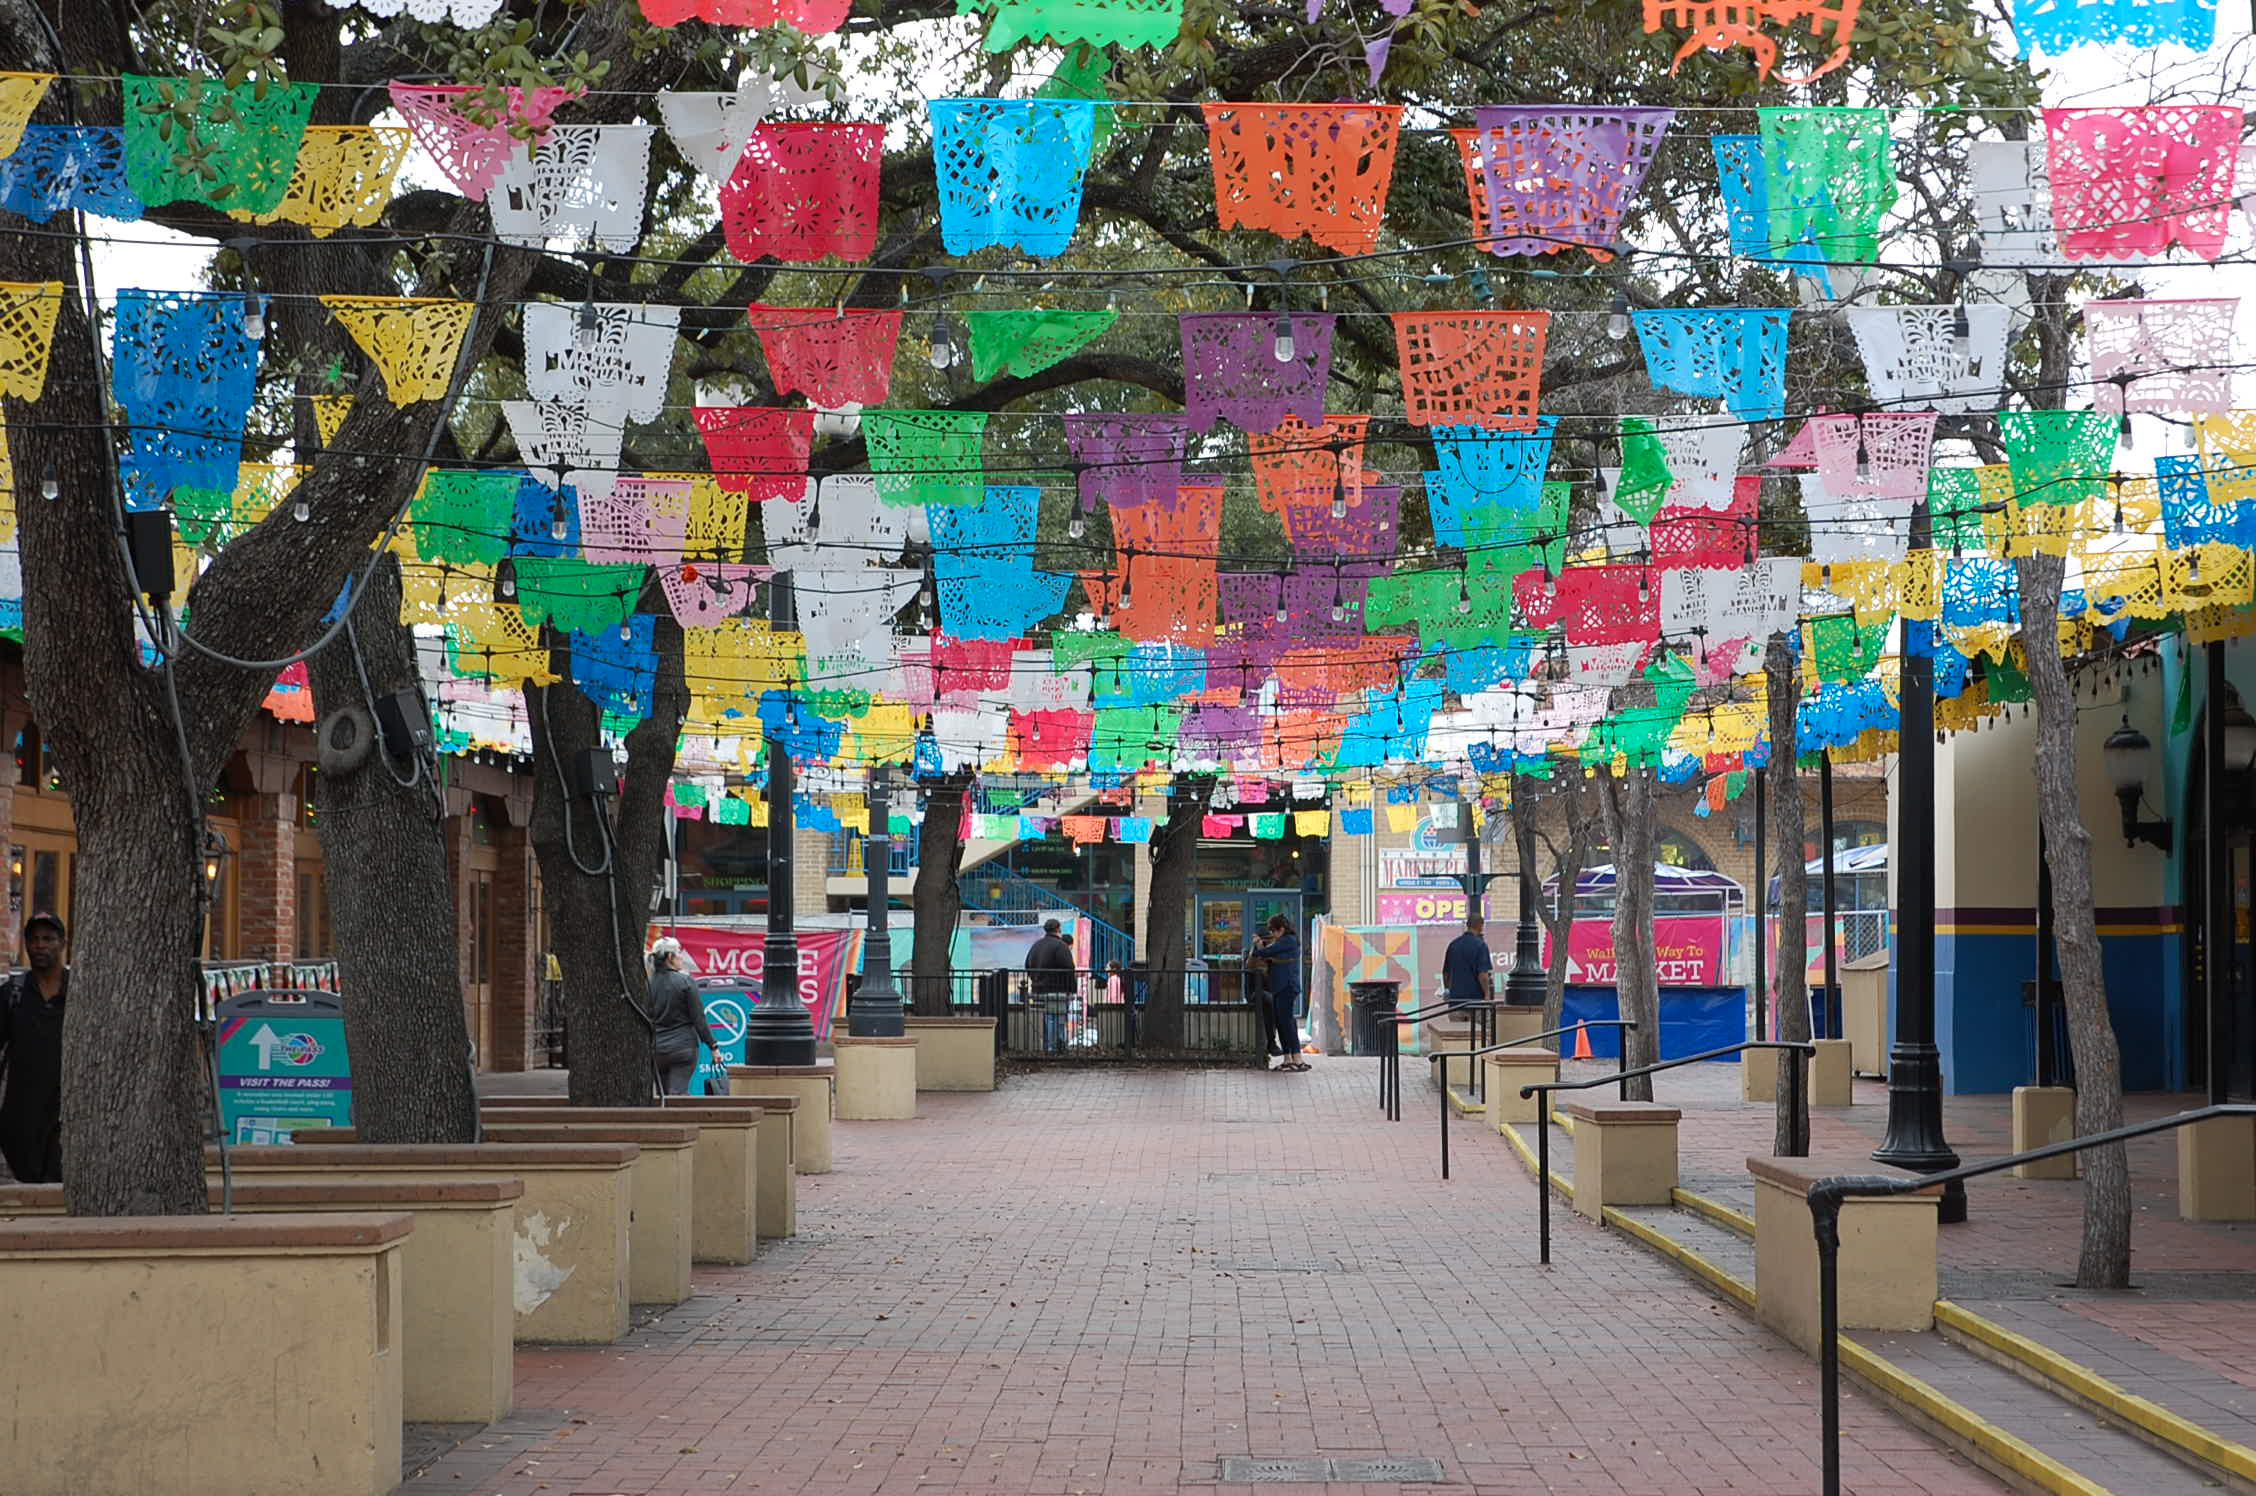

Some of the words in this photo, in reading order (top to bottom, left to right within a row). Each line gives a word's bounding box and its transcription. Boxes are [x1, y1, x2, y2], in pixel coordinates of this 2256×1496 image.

[1416, 899, 1485, 919] OPE
[705, 948, 819, 976] MOE
[1656, 946, 1684, 960] Way
[1687, 945, 1704, 957] To
[1585, 960, 1704, 983] MKET
[240, 1077, 272, 1087] VISIT
[272, 1077, 296, 1088] THE
[297, 1078, 331, 1088] PASS!
